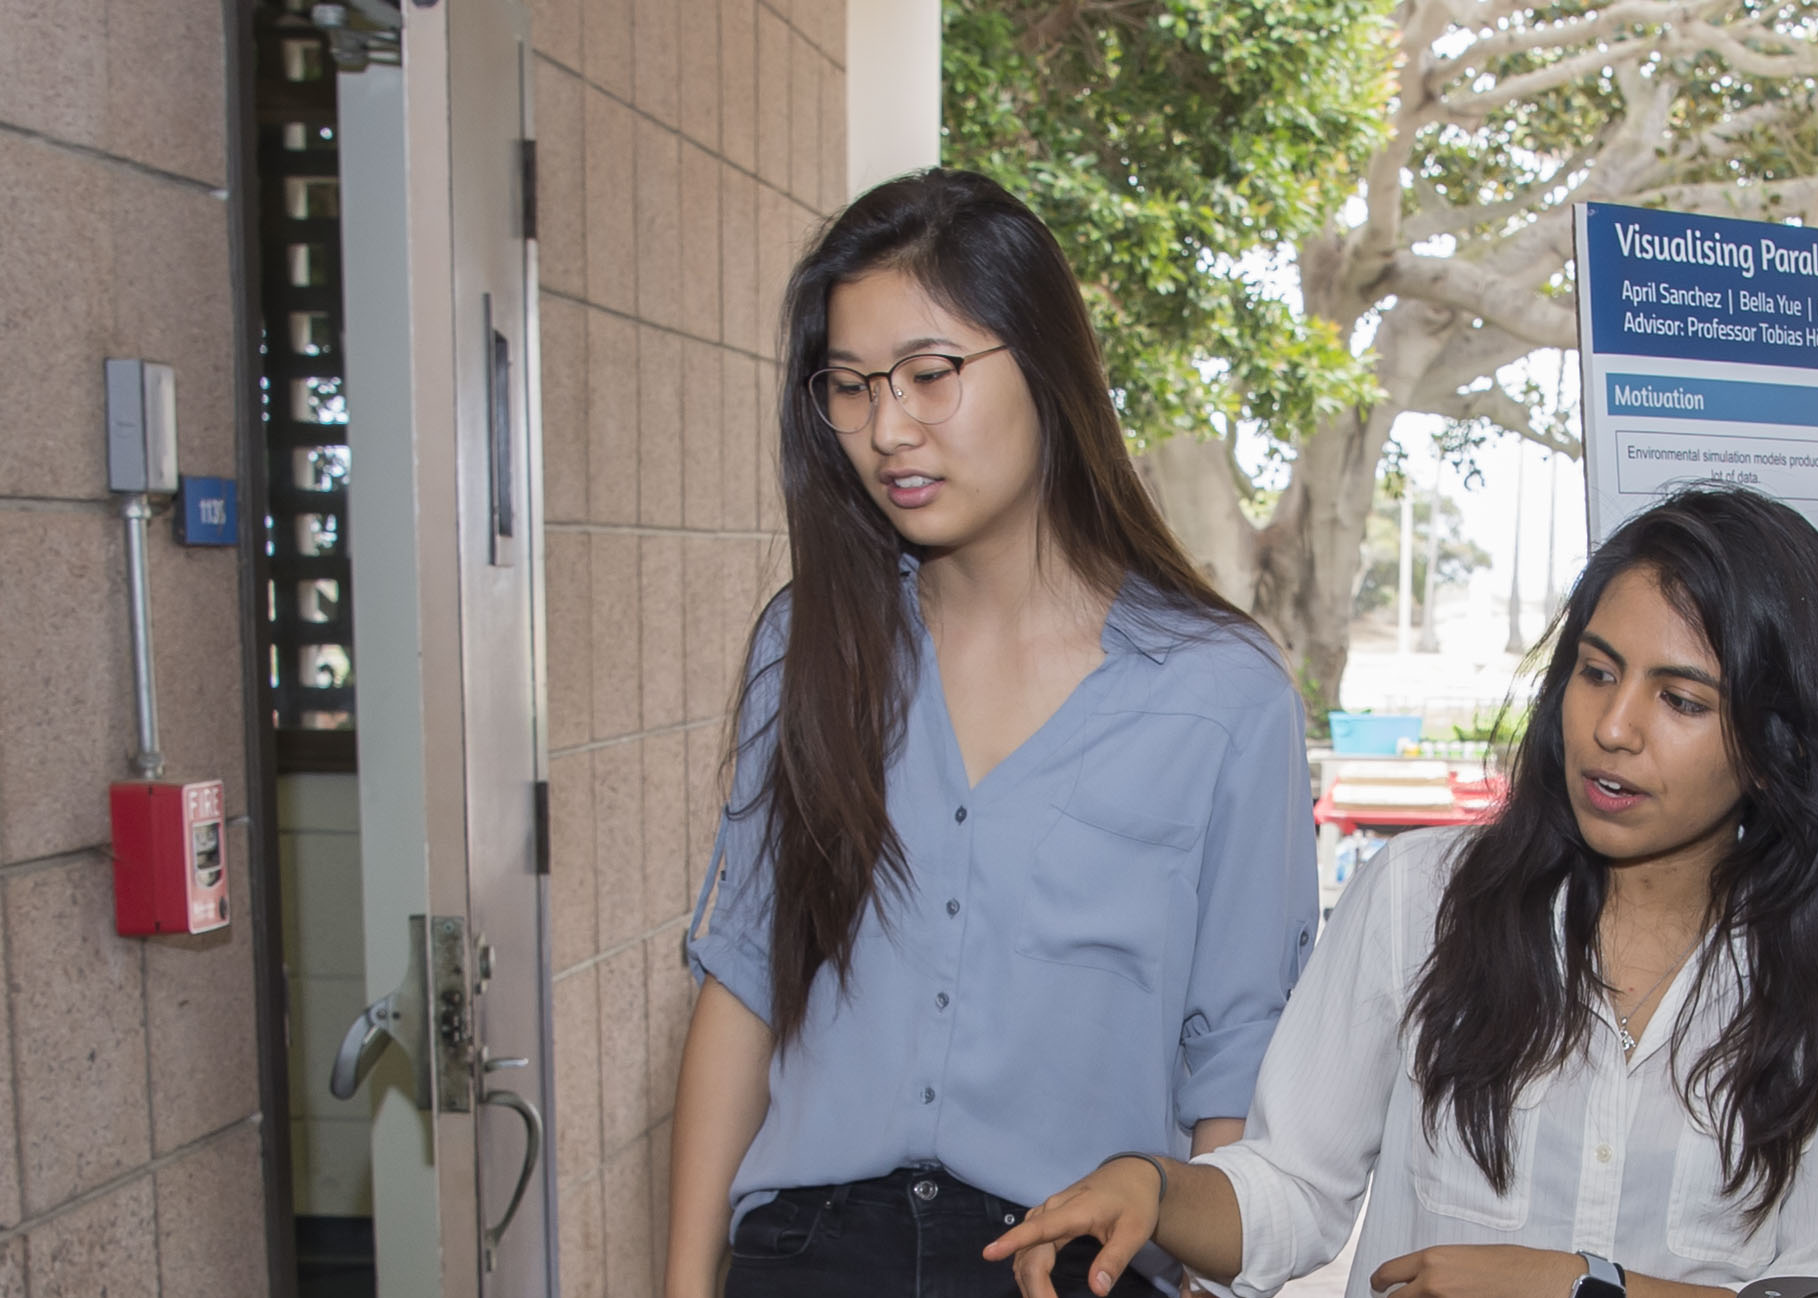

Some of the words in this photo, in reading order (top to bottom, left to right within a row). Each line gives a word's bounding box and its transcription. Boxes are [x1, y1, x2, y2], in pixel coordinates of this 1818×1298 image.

[1614, 222, 1754, 277] Visualising
[1622, 280, 1656, 308] April
[1659, 284, 1721, 309] Sanchez
[1740, 290, 1774, 313] Bella
[1777, 294, 1802, 316] Yue
[1624, 312, 1684, 336] Advisor:
[1688, 317, 1756, 342] Professor
[1759, 322, 1802, 346] Tobias
[1614, 384, 1704, 410] Motivation
[1627, 445, 1700, 462] Environmental
[1703, 450, 1750, 463] simulation
[1753, 452, 1786, 466] models
[1711, 470, 1722, 481] lot
[1726, 471, 1734, 482] of
[1738, 471, 1760, 484] data.
[189, 788, 221, 820] FIRE
